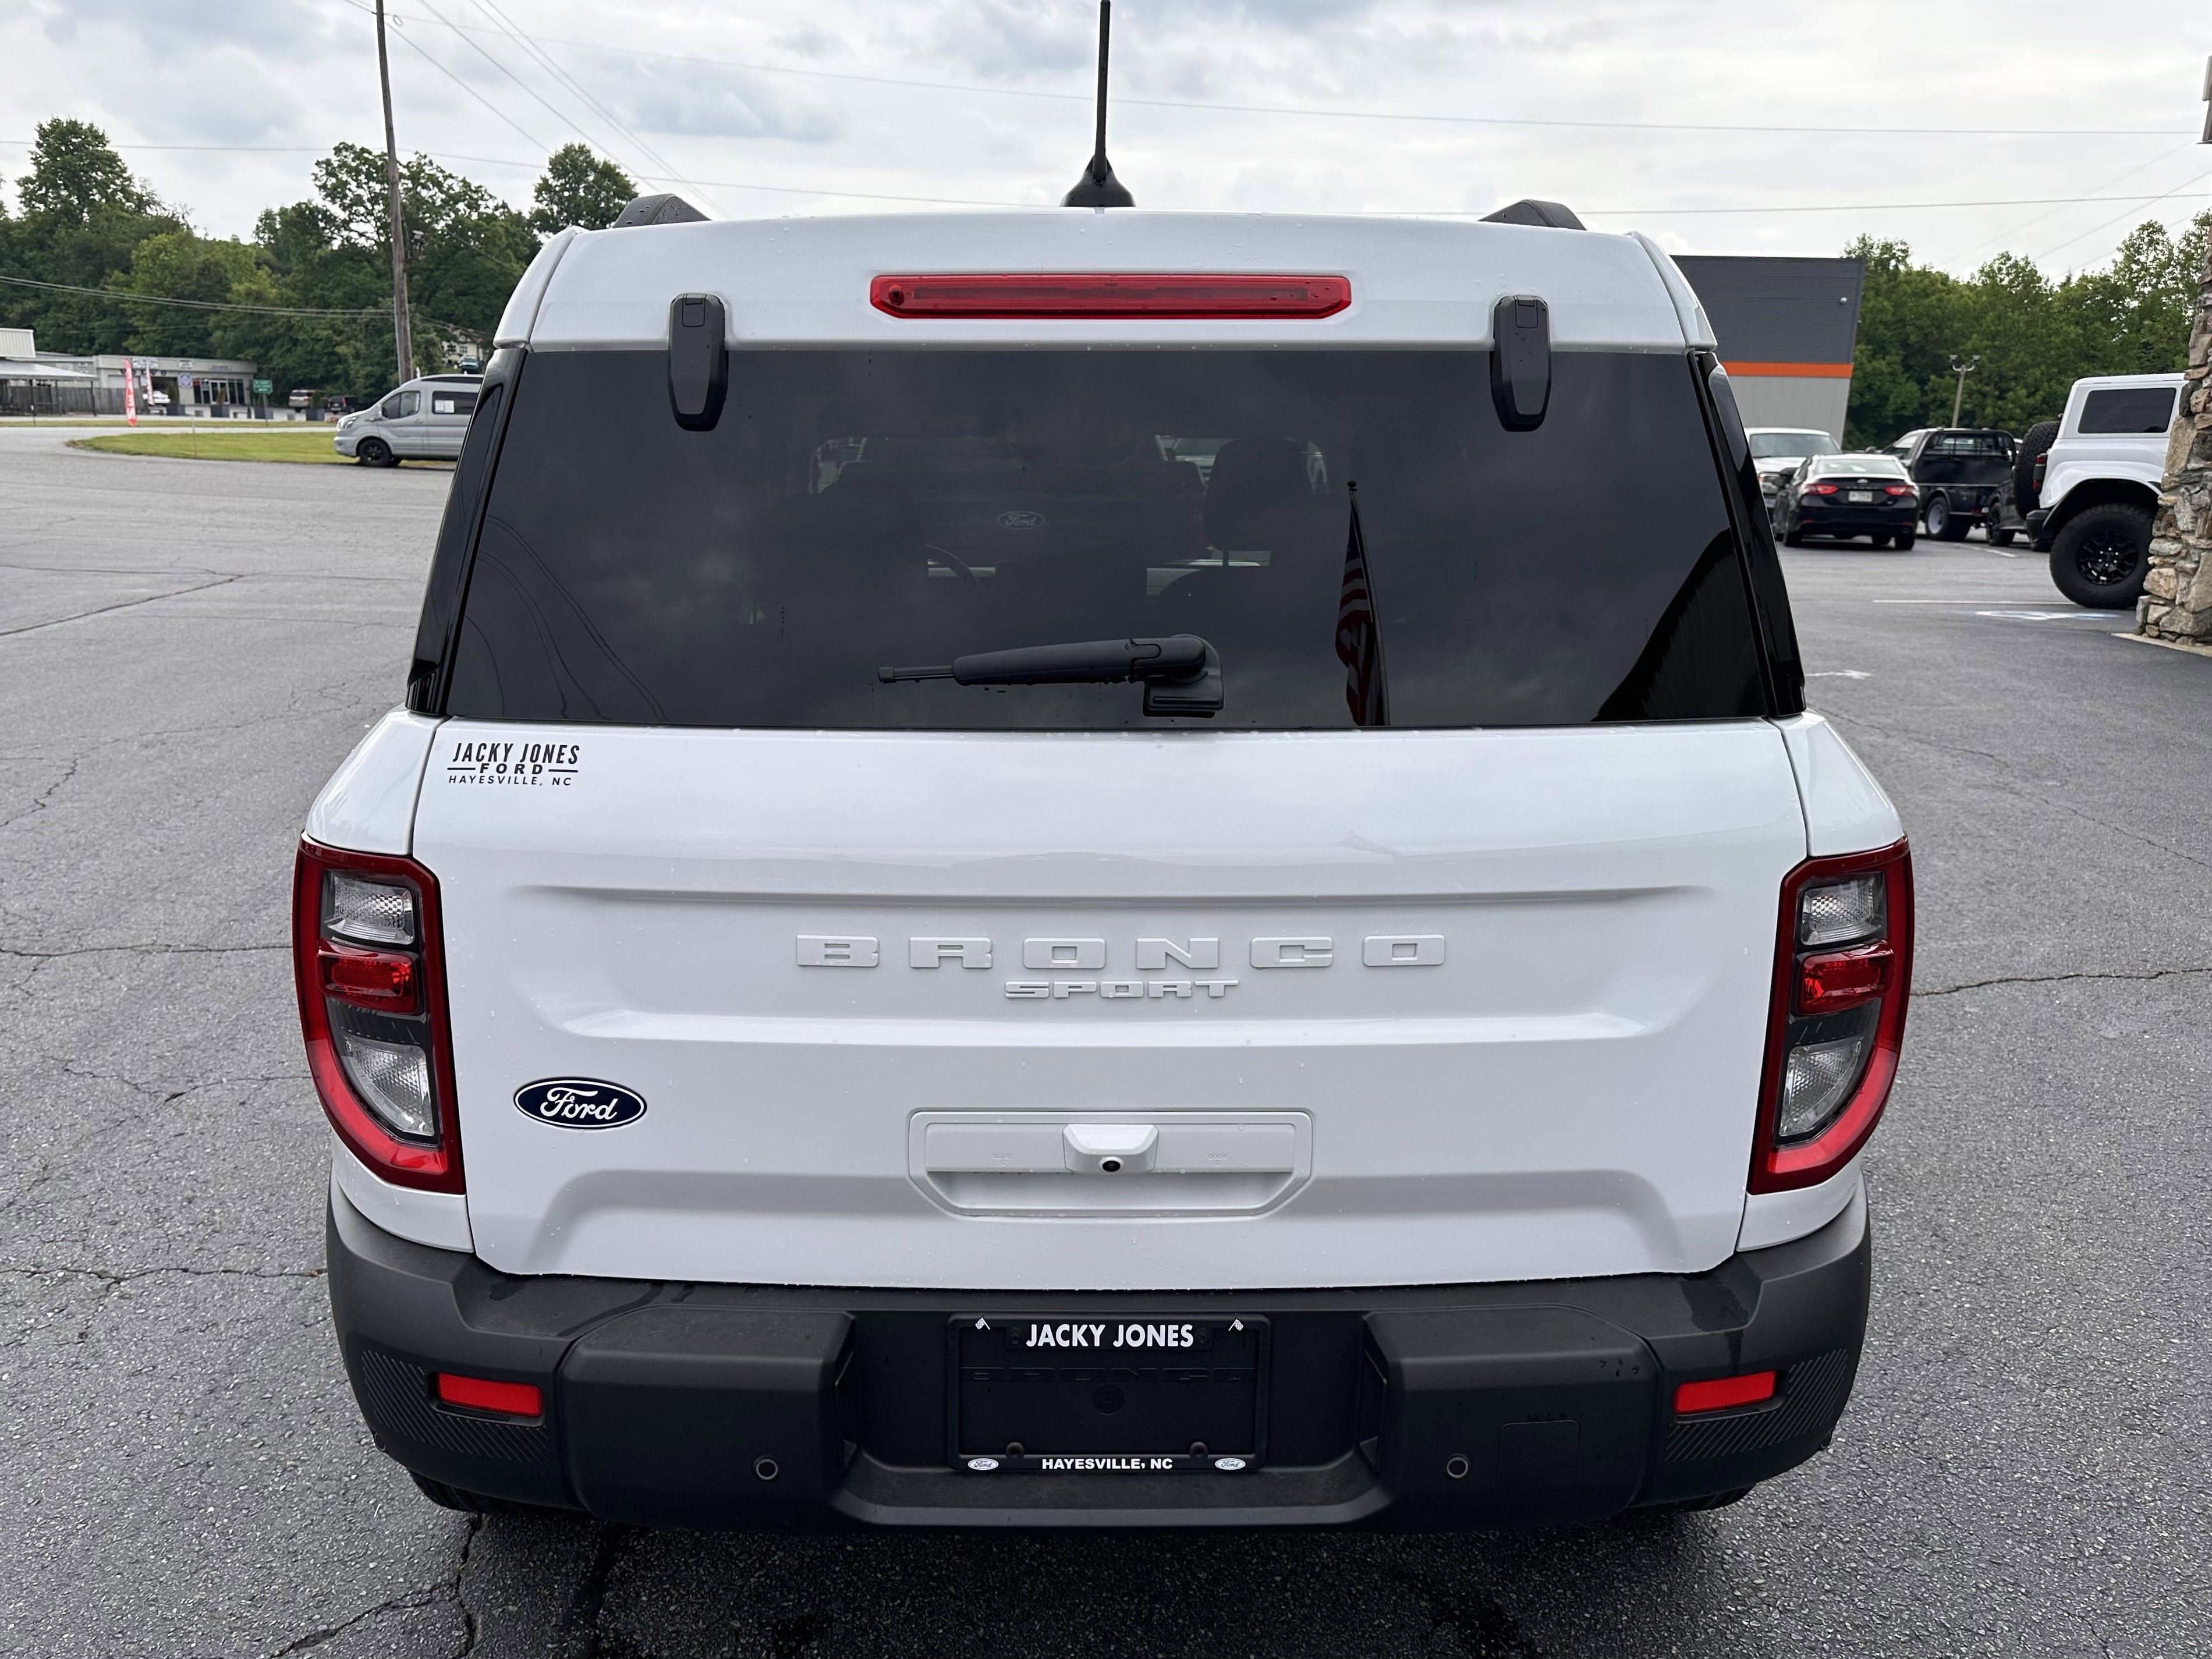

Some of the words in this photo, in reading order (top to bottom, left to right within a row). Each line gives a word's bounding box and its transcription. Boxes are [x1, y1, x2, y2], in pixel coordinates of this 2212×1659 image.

[1005, 513, 1037, 526] Ford
[452, 743, 514, 762] JACKY
[520, 743, 580, 764] JONES
[480, 763, 543, 775] FORD
[449, 775, 543, 786] HAYESVILLE,
[552, 777, 572, 786] NC
[796, 934, 1446, 970] BRONCO
[1004, 979, 1240, 999] SPORT
[540, 1087, 619, 1120] Ford
[1026, 1324, 1105, 1348] JACKY
[1113, 1324, 1194, 1348] JONES
[974, 1460, 992, 1468] Ford
[1042, 1458, 1146, 1470] HAYESVILLE,
[1150, 1458, 1173, 1469] NC
[1221, 1460, 1239, 1468] Ford
